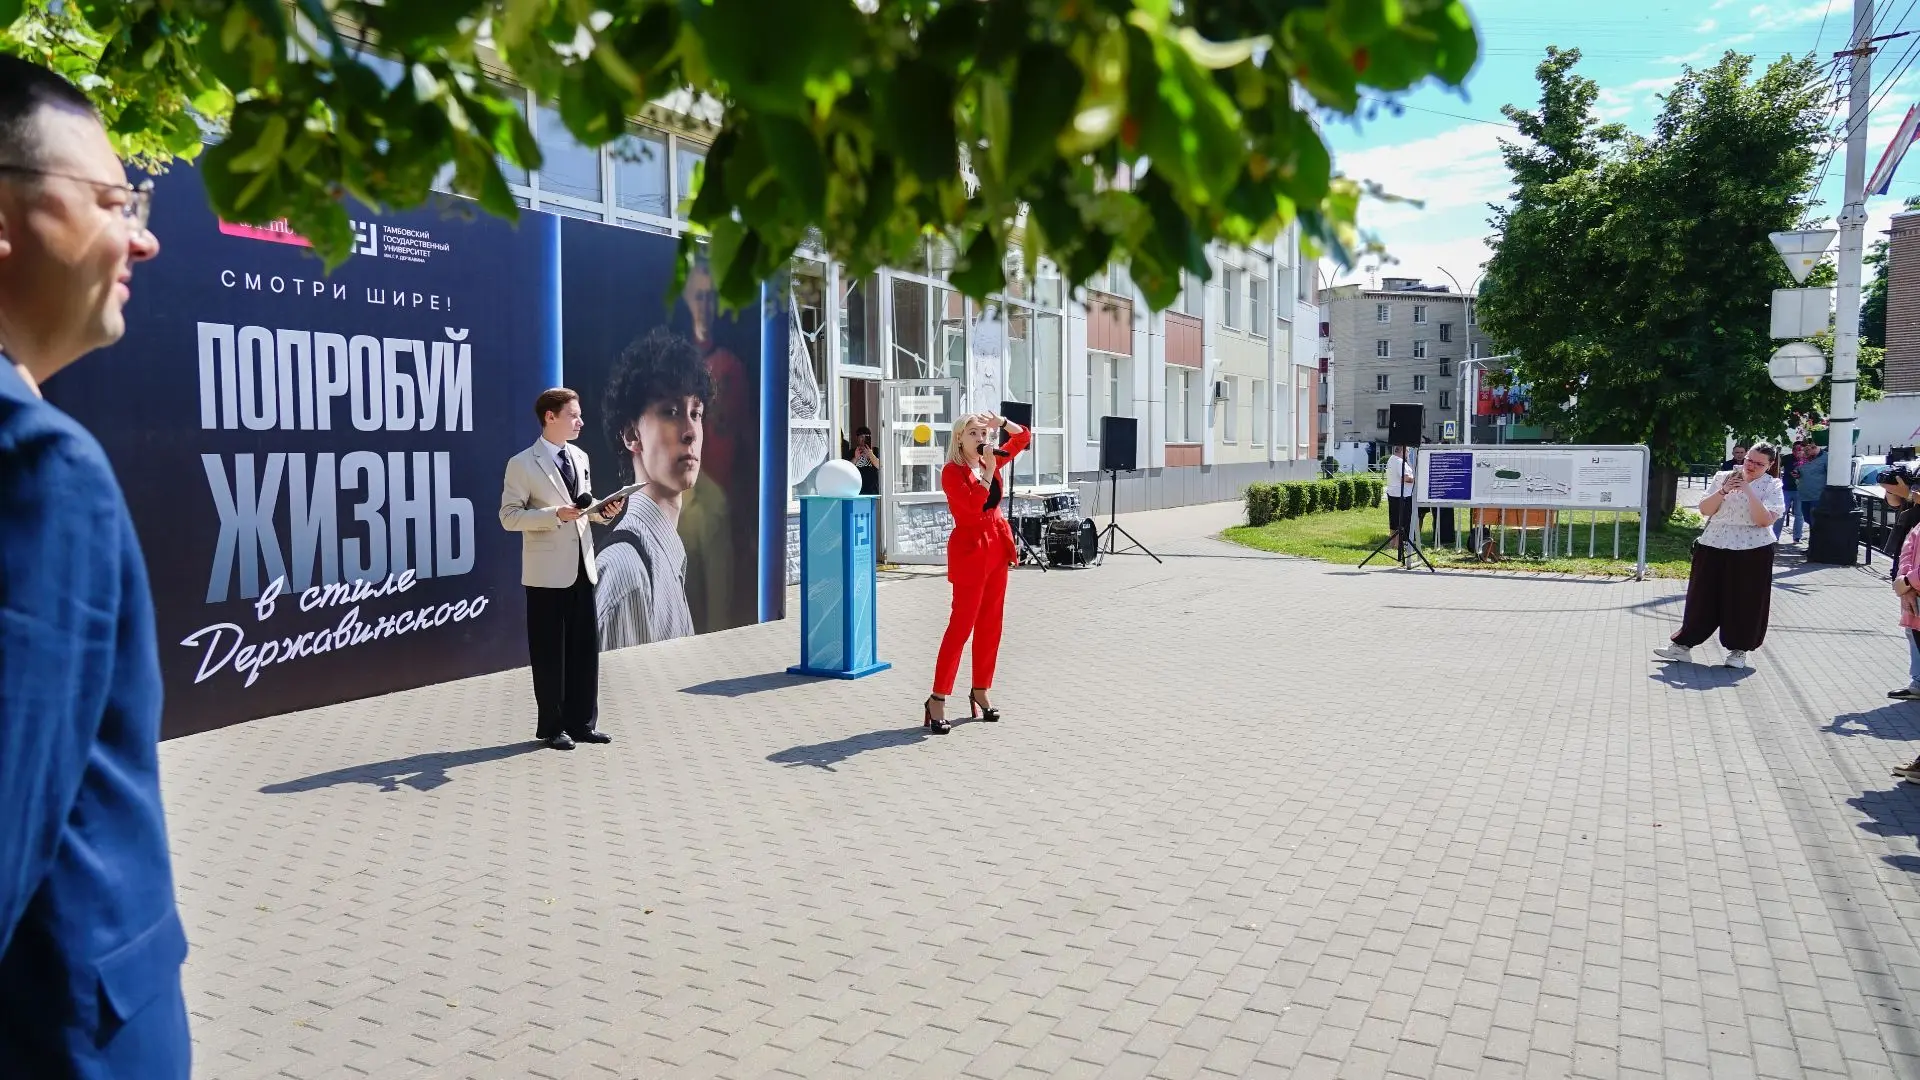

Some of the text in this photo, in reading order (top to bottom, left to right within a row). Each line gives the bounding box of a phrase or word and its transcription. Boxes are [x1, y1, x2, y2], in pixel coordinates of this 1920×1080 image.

[383, 225, 430, 239] ТАМБОВСКИЙ
[383, 235, 450, 251] ГОСУДАРСТВЕННЫЙ
[383, 244, 431, 257] УНИВЕРСИТЕТ
[221, 270, 451, 311] СМОТРИ ШИРЕ!
[197, 321, 473, 432] ПОПРОБУЙ
[200, 450, 476, 604] ЖИЗНЬ
[254, 568, 417, 621] в стиле
[180, 595, 489, 688] Державинского
